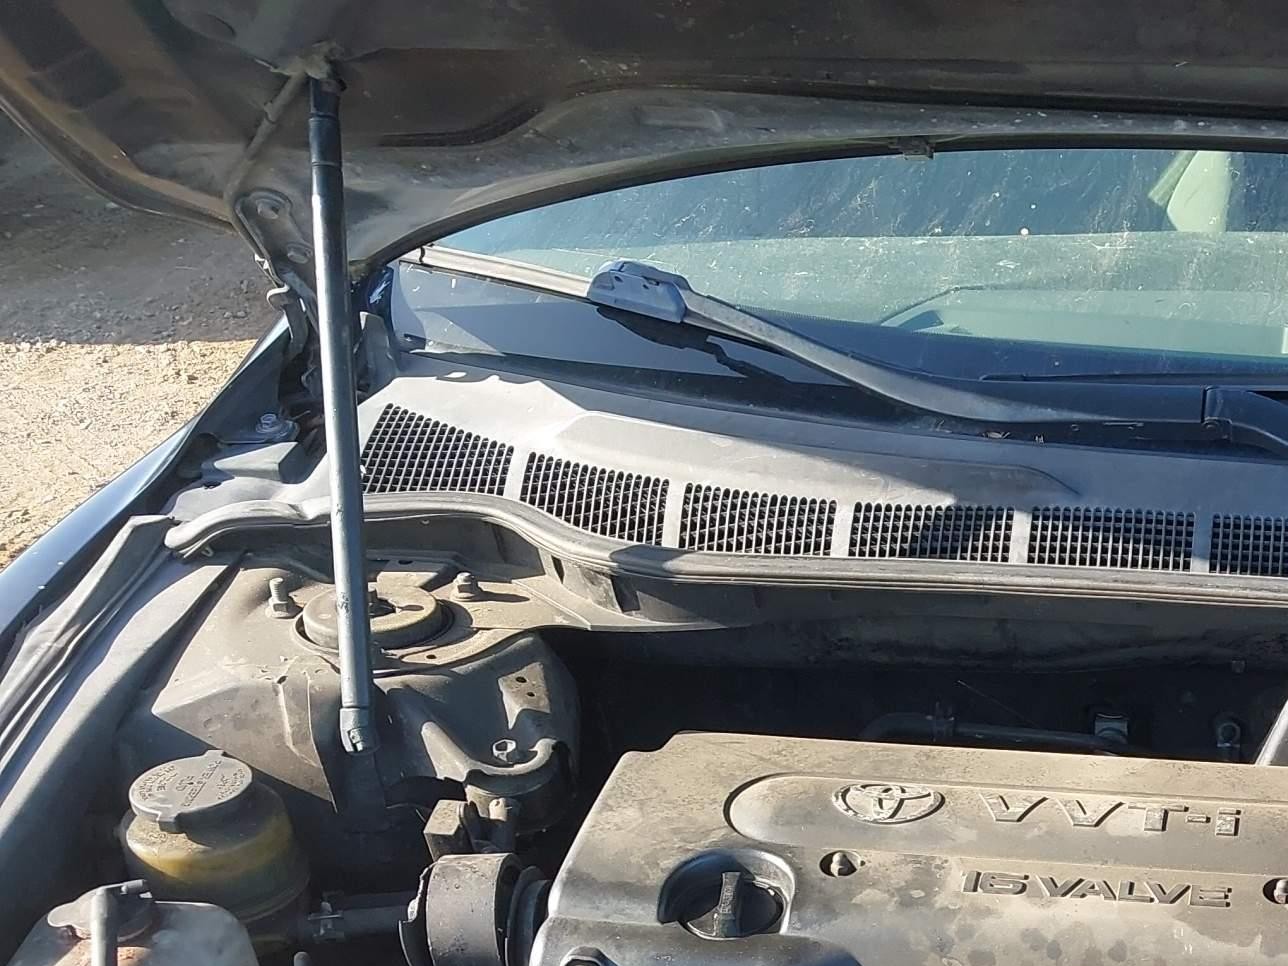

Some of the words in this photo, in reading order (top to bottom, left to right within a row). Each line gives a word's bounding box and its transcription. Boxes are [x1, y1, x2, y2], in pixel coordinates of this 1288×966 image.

[979, 791, 1243, 837] VVT-i
[961, 870, 1031, 897] 16
[1036, 875, 1232, 909] VALVE
